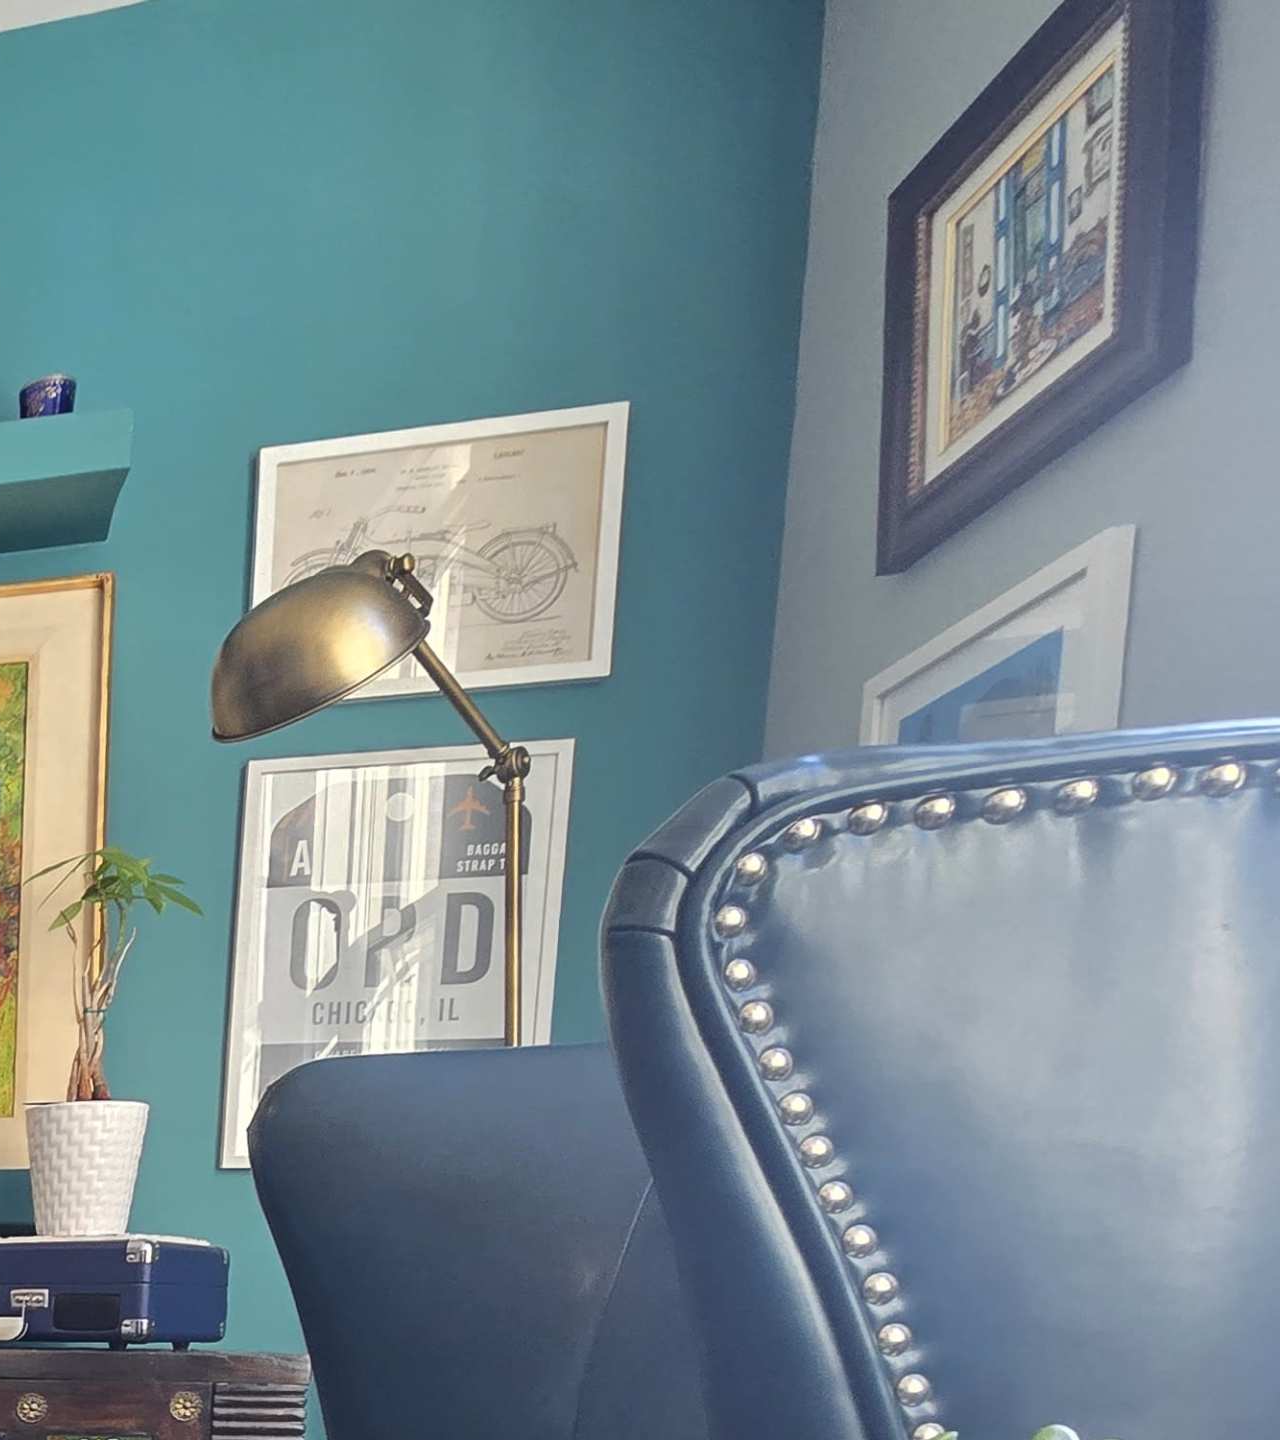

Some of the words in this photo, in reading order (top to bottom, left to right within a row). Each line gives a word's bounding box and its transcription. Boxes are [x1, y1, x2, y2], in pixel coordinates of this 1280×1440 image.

[466, 841, 507, 857] BAGGA
[456, 859, 495, 873] STRAP
[439, 998, 460, 1022] IL
